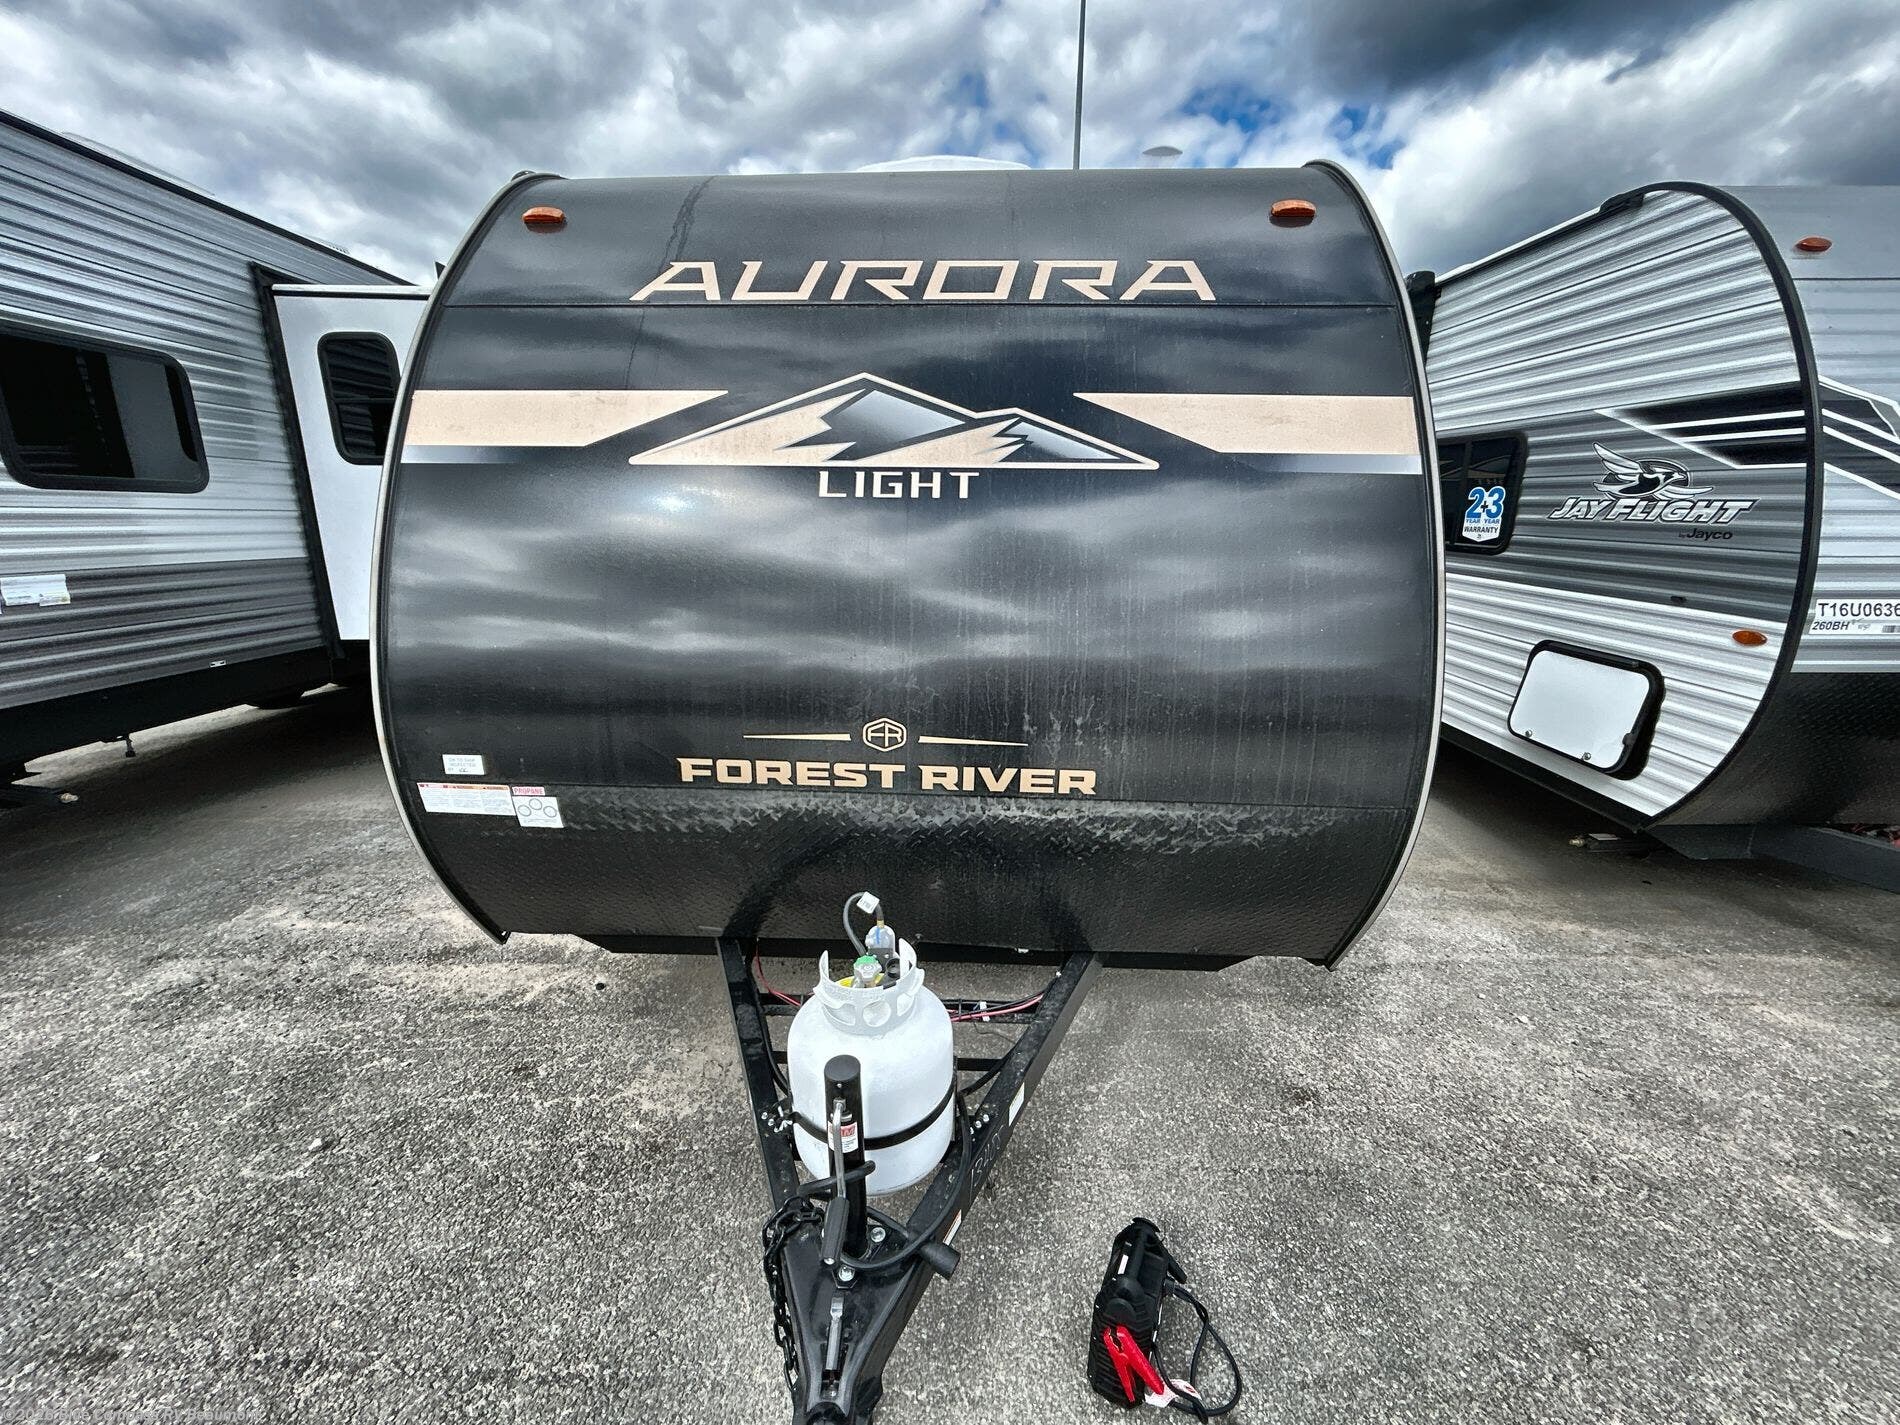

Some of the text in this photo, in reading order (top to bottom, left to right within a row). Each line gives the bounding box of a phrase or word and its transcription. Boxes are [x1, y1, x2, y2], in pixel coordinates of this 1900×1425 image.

[629, 260, 1216, 301] AURORA
[818, 471, 980, 499] LIGHT
[1687, 528, 1733, 541] Jayco
[1812, 621, 1850, 631] 260BH
[676, 757, 1097, 795] FOREST RIVER
[513, 786, 544, 795] PROPANE
